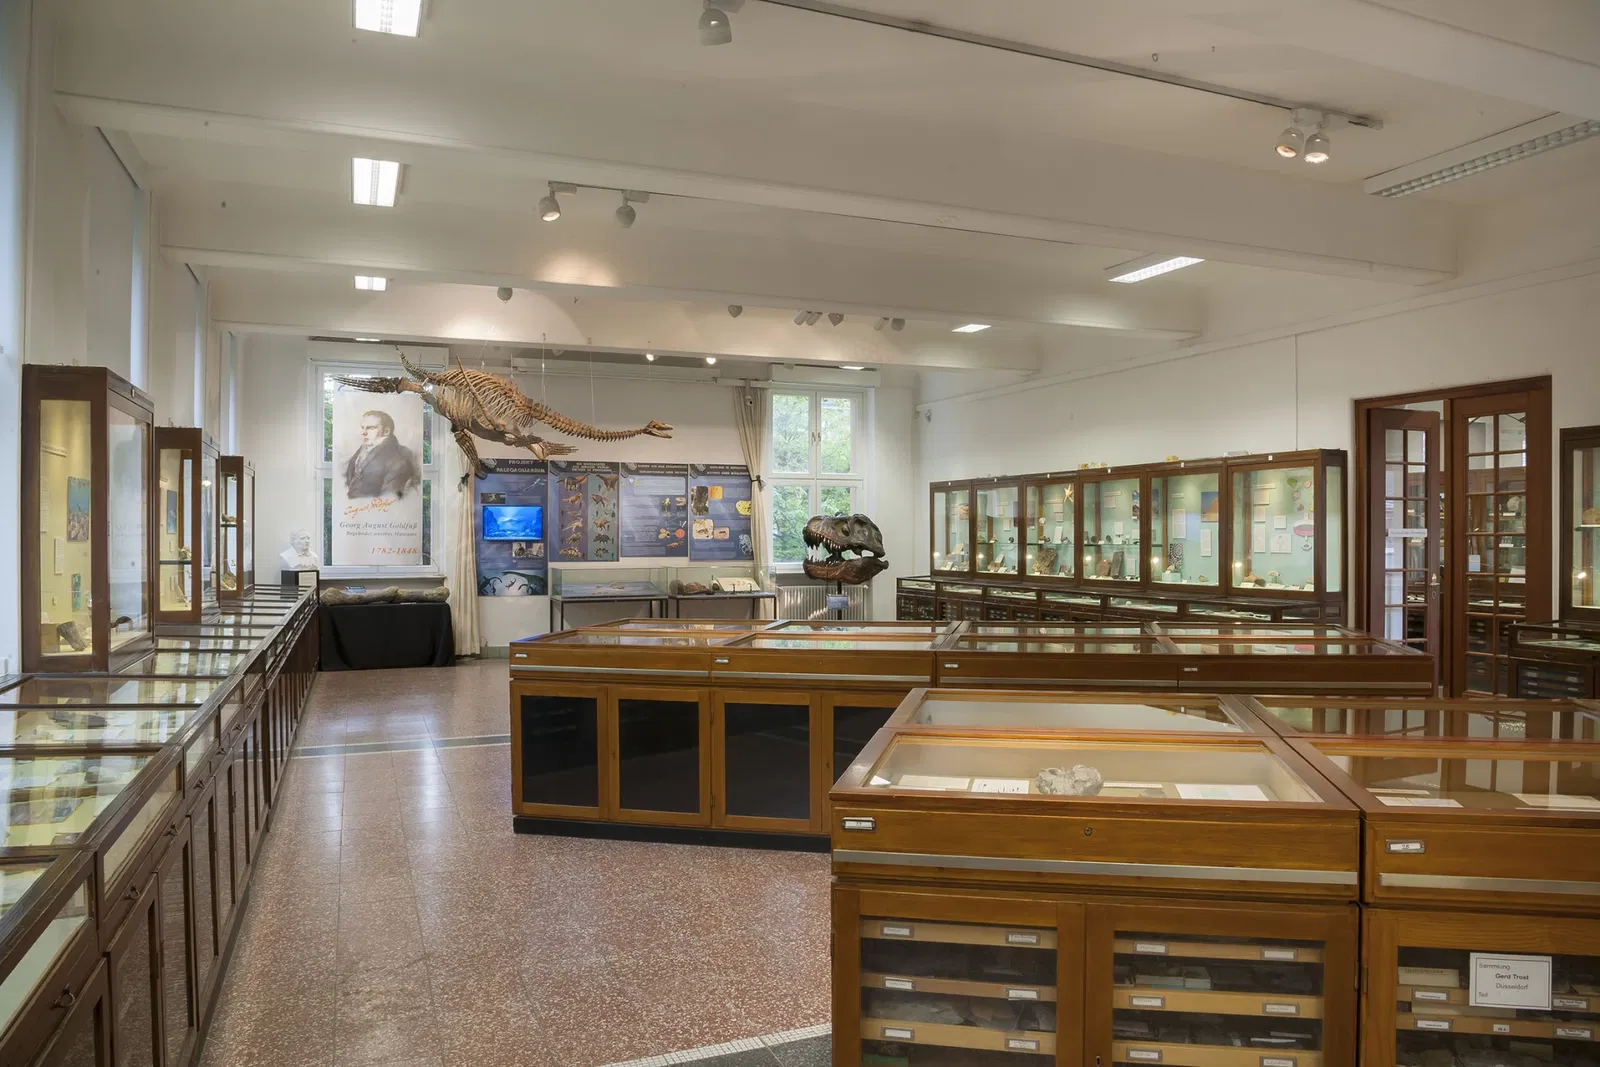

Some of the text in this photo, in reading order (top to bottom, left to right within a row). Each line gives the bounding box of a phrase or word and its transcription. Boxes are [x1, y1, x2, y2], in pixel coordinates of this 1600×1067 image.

[339, 521, 418, 530] Georg August Goldfuß
[1478, 963, 1511, 971] Sammlung
[1495, 982, 1529, 990] Düsseldorf
